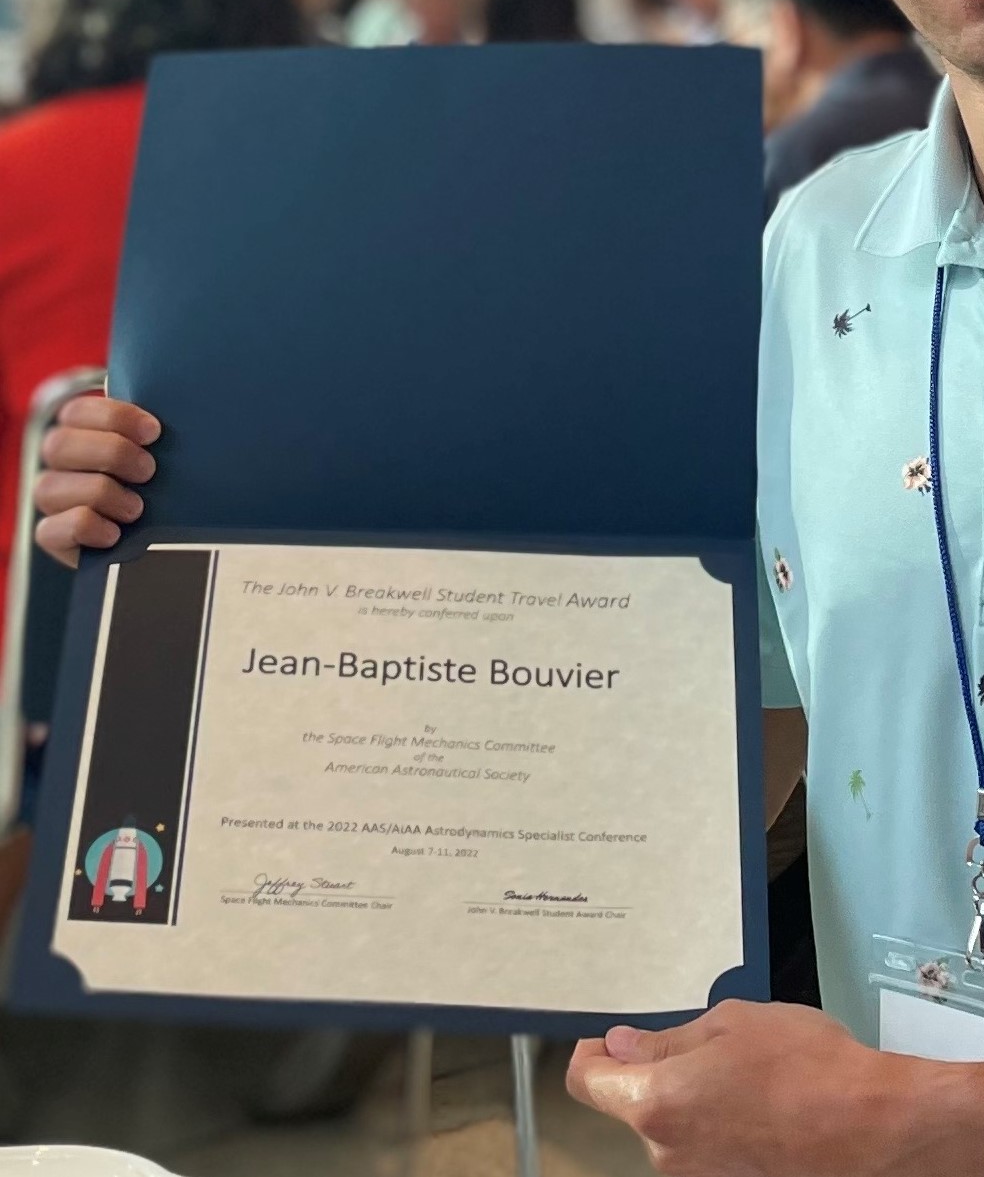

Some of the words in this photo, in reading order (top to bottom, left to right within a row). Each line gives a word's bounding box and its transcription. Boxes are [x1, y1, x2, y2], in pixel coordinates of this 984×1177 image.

[242, 580, 273, 595] The
[277, 582, 319, 597] John
[345, 584, 432, 601] Breakwell
[437, 588, 504, 605] Student
[511, 591, 563, 607] Travel
[566, 592, 631, 610] Award
[358, 606, 367, 615] is
[372, 606, 415, 619] hereby
[418, 608, 480, 621] conferred
[483, 612, 515, 622] upon
[242, 648, 477, 686] Jean-Baptiste
[490, 658, 620, 689] Bouvier
[424, 724, 438, 735] by
[302, 731, 324, 744] the
[327, 733, 366, 746] Space
[370, 734, 407, 749] Flight
[411, 736, 480, 751] Mechanics
[484, 739, 556, 754] Committee
[413, 751, 426, 763] of
[427, 753, 444, 763] the
[324, 761, 388, 774] American
[391, 764, 480, 779] Astronautical
[483, 768, 531, 783] Society
[221, 816, 284, 830] Presented
[287, 821, 299, 830] at
[303, 820, 324, 832] the
[326, 821, 358, 833] 2022
[425, 825, 515, 839] Astrodynamics
[517, 829, 576, 842] Specialist
[578, 830, 648, 843] Conference
[391, 846, 424, 857] August
[454, 848, 479, 858] 2022
[220, 895, 246, 905] Space
[248, 897, 271, 907] Flight
[273, 897, 319, 908] Mechanics
[321, 899, 369, 910] Committee
[371, 902, 394, 911] Chair
[467, 906, 488, 915] John
[499, 907, 540, 917] Breakwell
[542, 909, 574, 918] Student
[576, 911, 604, 920] Award
[605, 911, 628, 920] Chair
